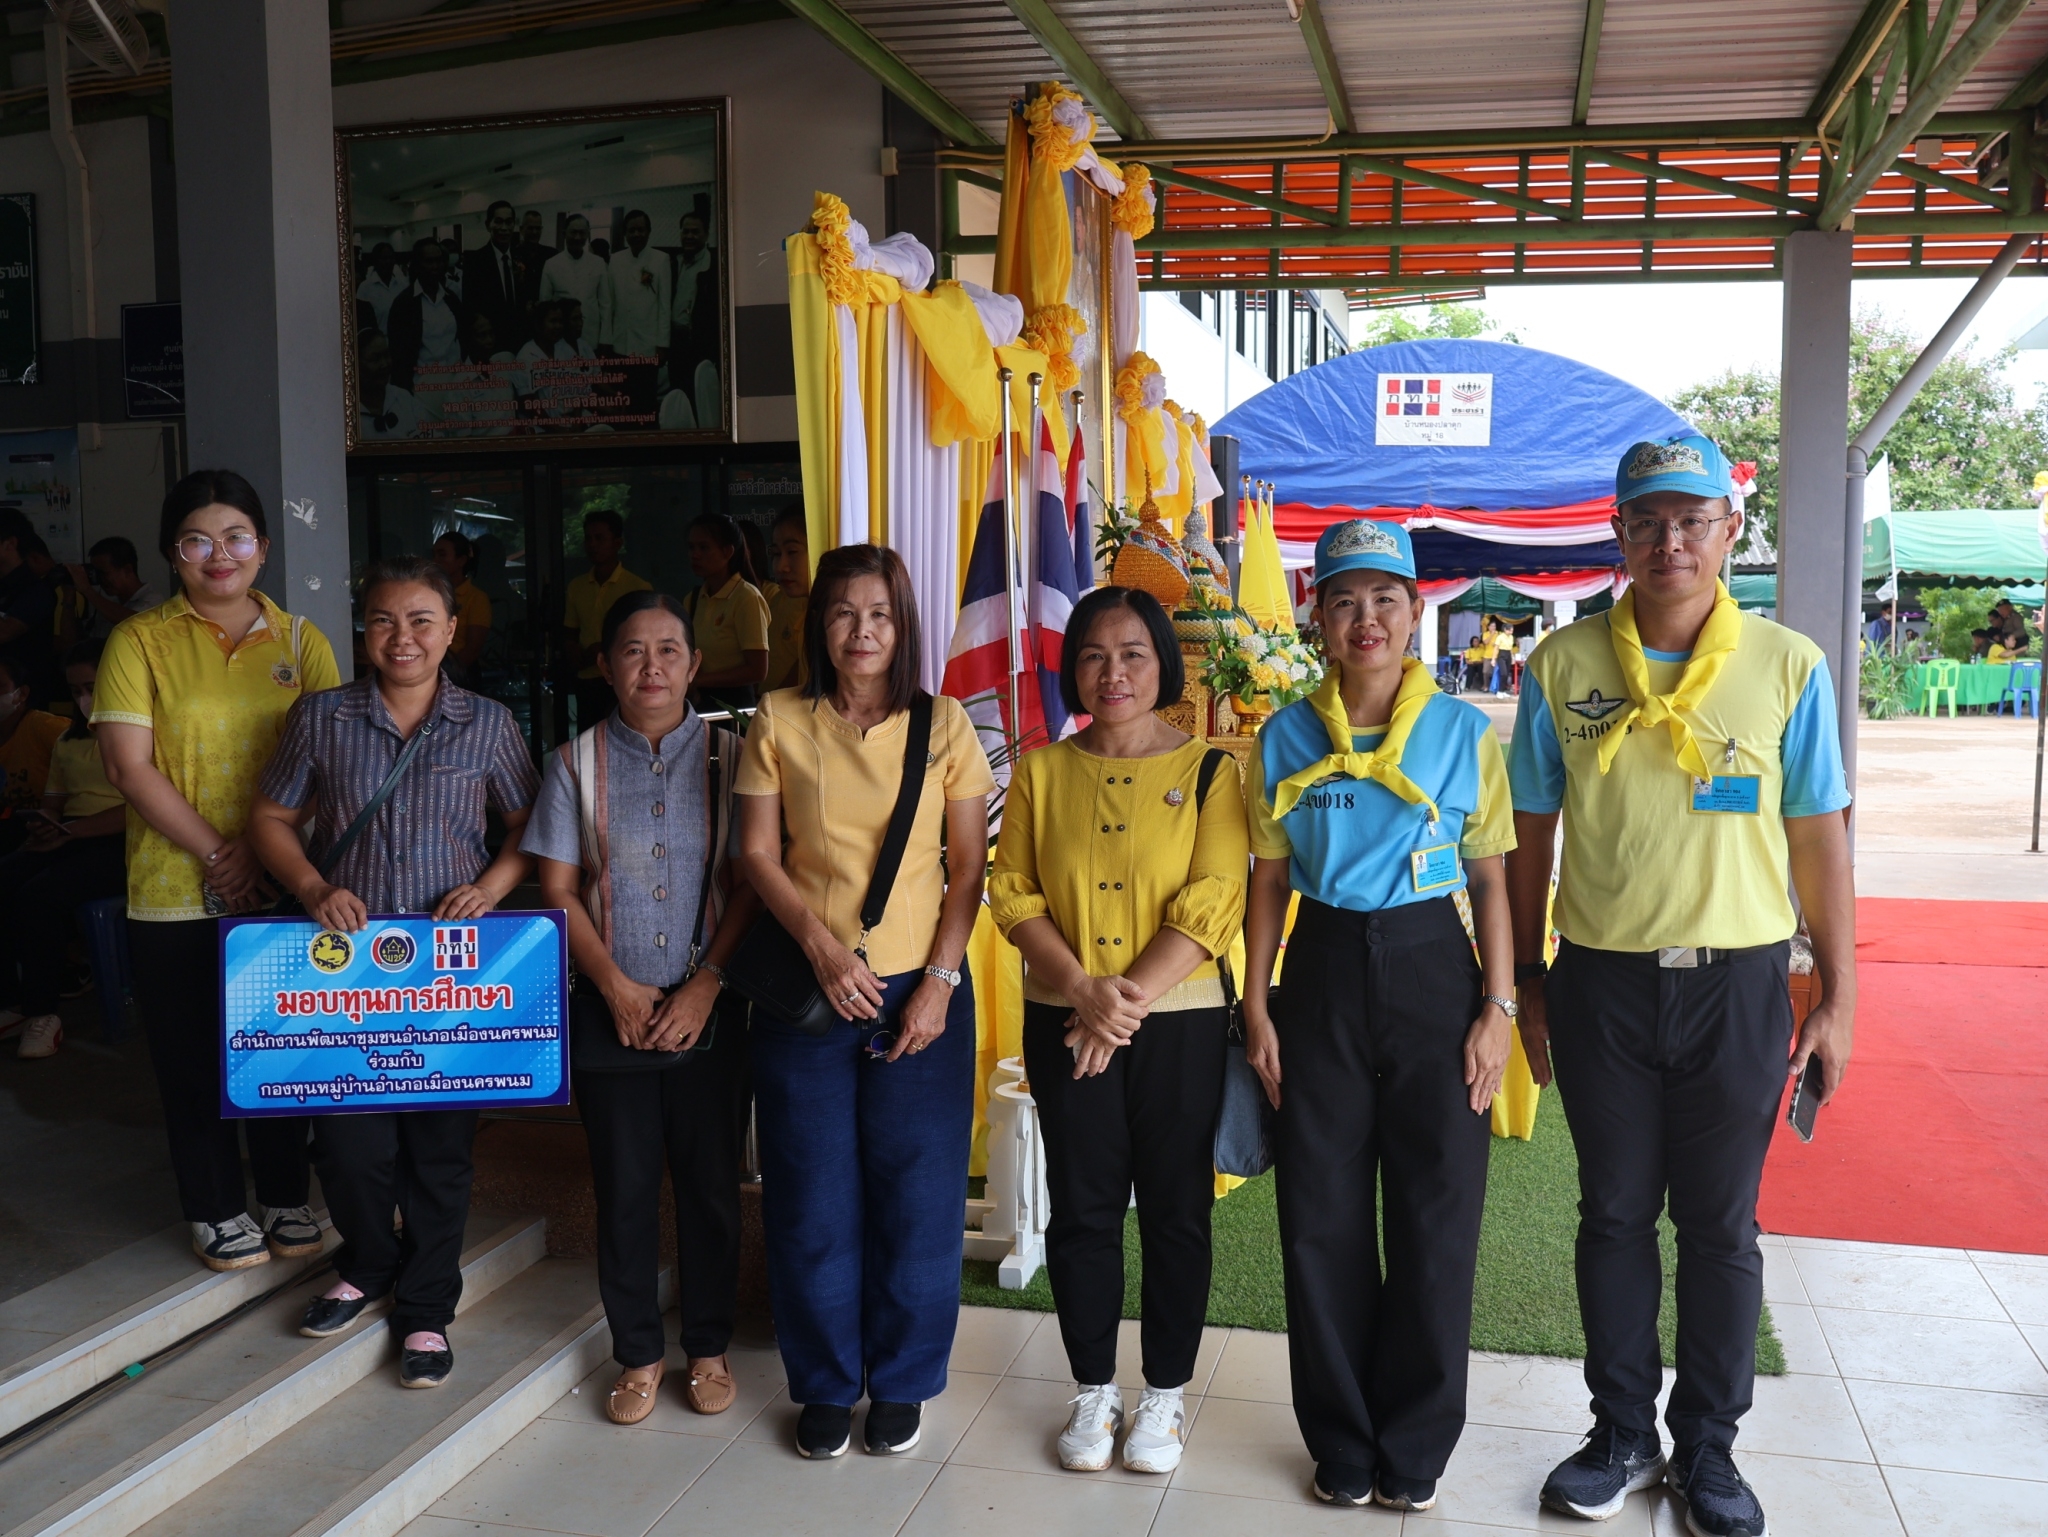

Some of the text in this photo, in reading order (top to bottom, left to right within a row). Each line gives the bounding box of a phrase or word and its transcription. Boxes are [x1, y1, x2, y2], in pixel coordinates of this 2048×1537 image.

[442, 399, 518, 413] พลตำรวจเอก
[525, 394, 558, 415] อดุลย์
[564, 391, 631, 409] แสงสิงแก้ว
[1388, 394, 1440, 403] กทบ
[727, 476, 803, 496] านสวัสดิการสังคม
[1564, 719, 1633, 744] 2-4ก0
[1290, 791, 1355, 813] -4ข018
[437, 939, 476, 955] กทบ
[276, 976, 513, 1022] มอบทุนการศึกษา
[231, 1026, 558, 1051] สำนักงานพัฒนาชุมชนอำเภอเมืองนครพนม
[368, 1052, 423, 1069] ร่วมกับ
[260, 1074, 531, 1100] กองทุนหมู่บ้านอำเภอเมืองนครพนม
